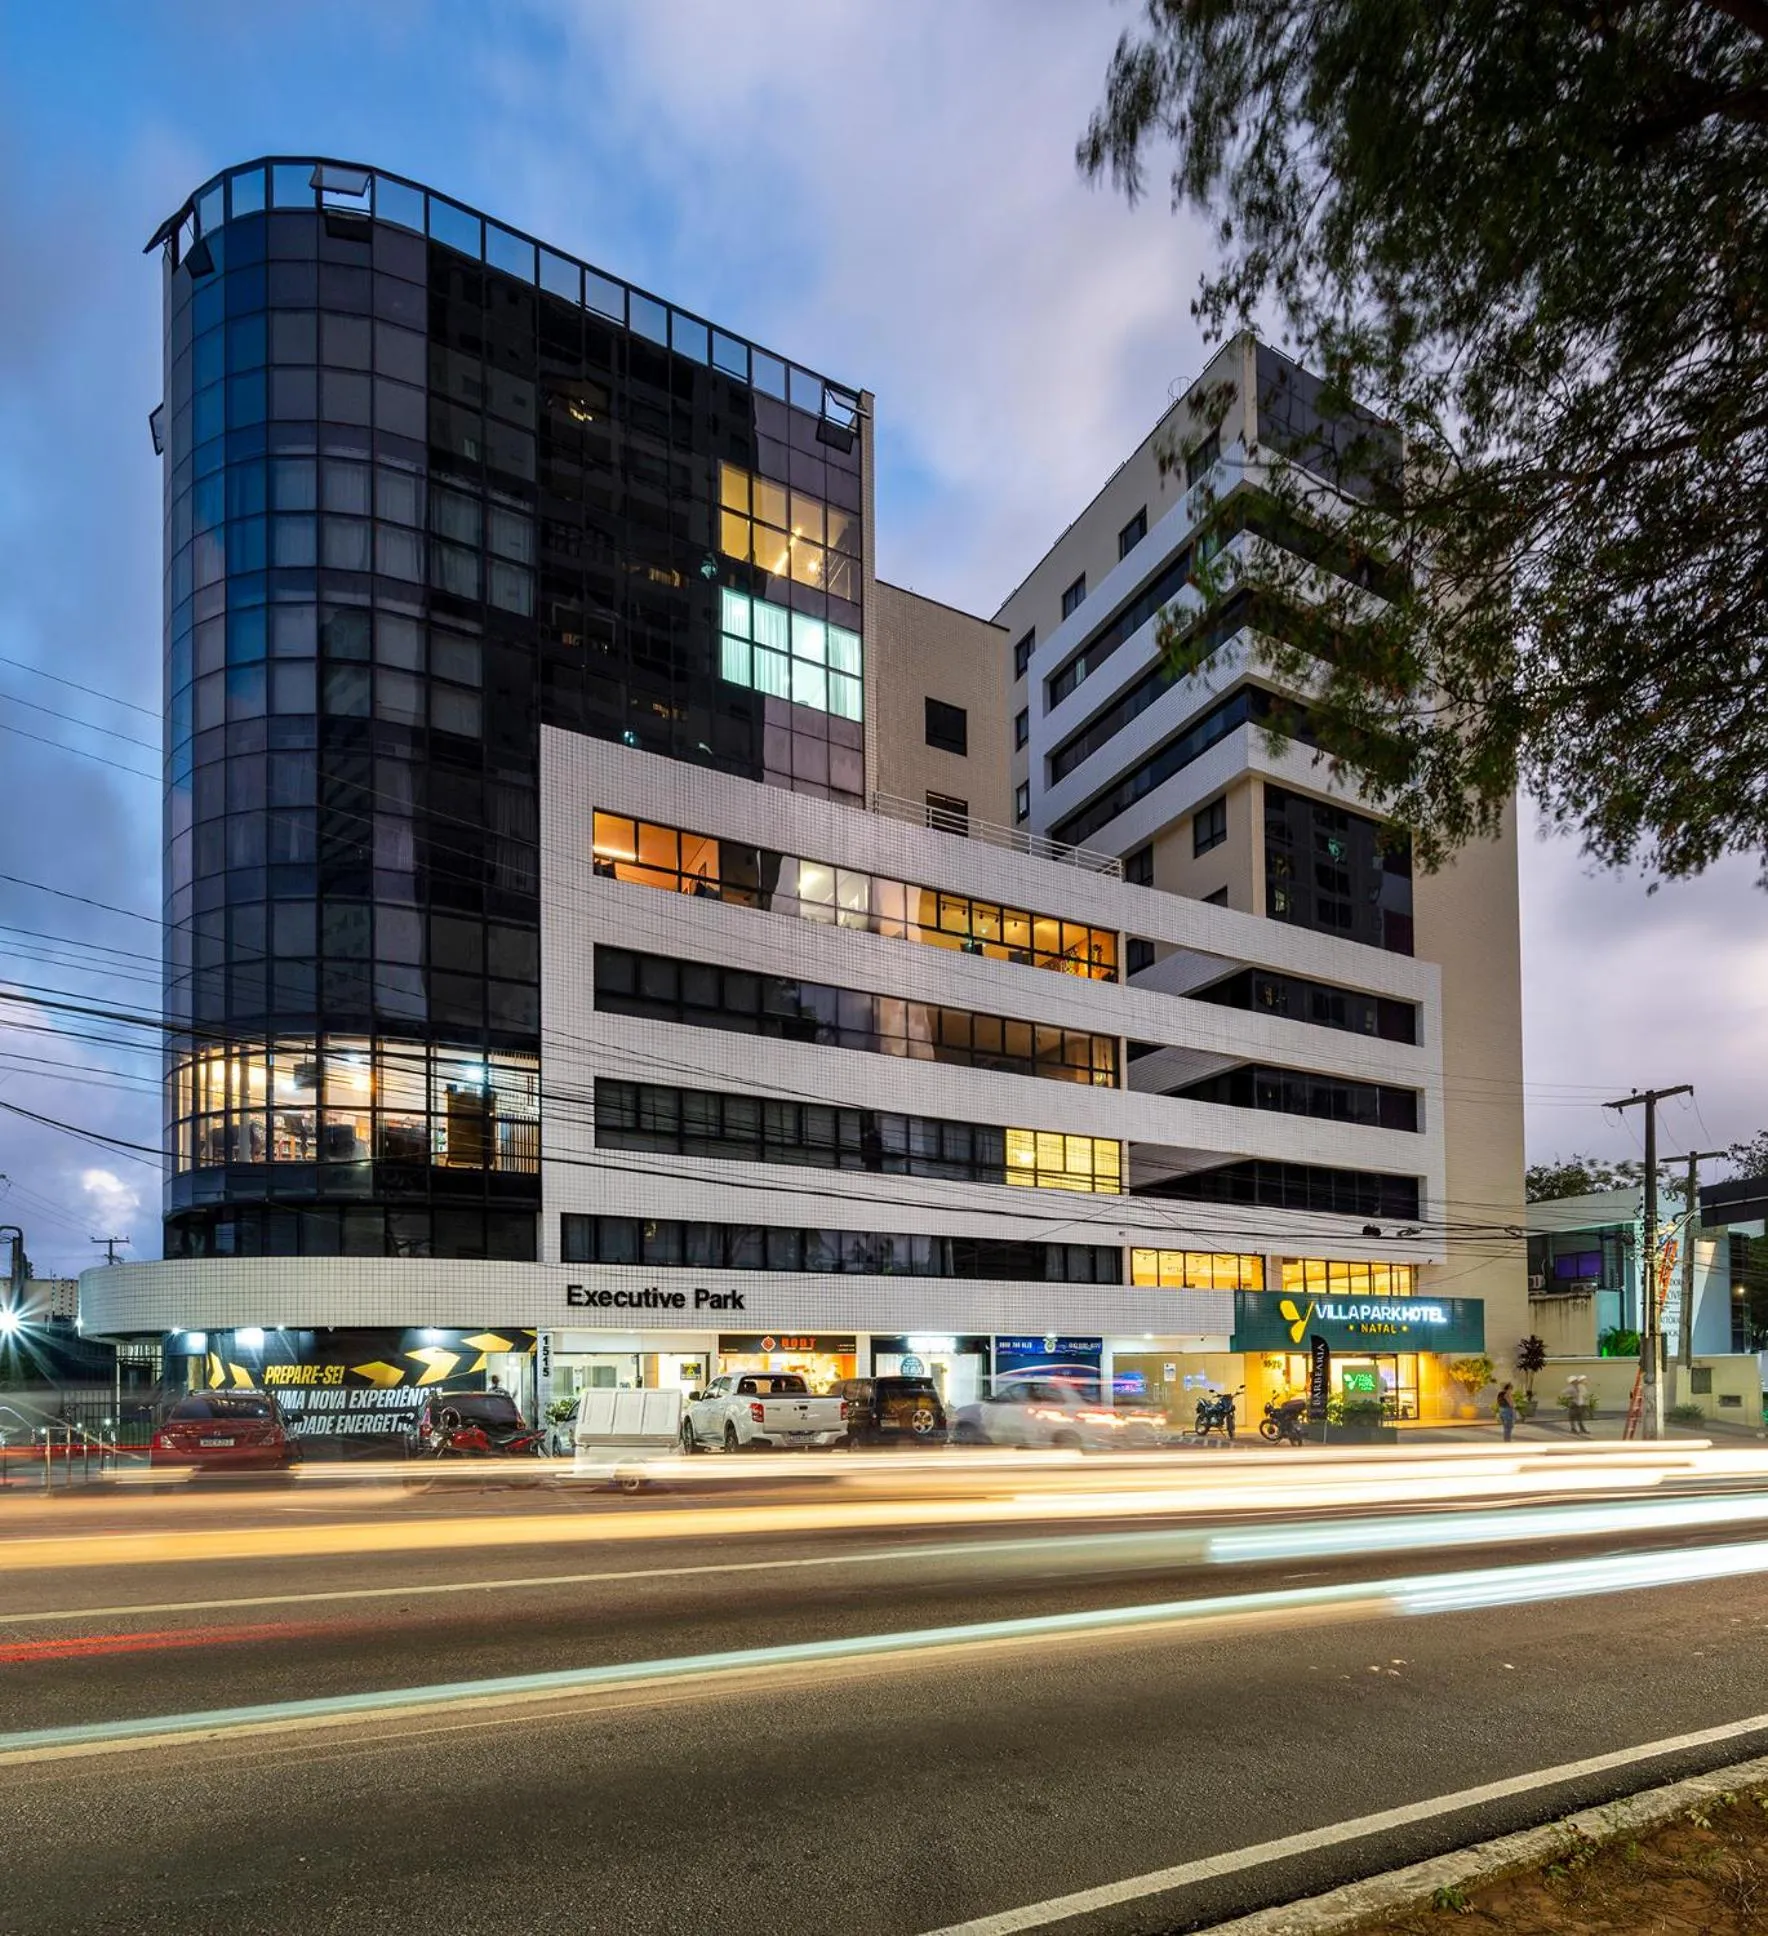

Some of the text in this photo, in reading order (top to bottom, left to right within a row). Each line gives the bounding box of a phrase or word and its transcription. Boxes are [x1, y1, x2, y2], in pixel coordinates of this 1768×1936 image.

[566, 1284, 746, 1310] Executive Park
[1401, 1307, 1447, 1323] HOTEL
[1360, 1323, 1398, 1334] NATAL
[542, 1335, 550, 1377] 1515
[264, 1366, 346, 1385] PREPARE-SE!
[1312, 1343, 1325, 1406] BARBEARIA
[307, 1390, 346, 1410] NOVA
[350, 1385, 443, 1408] EXPERIÊNC
